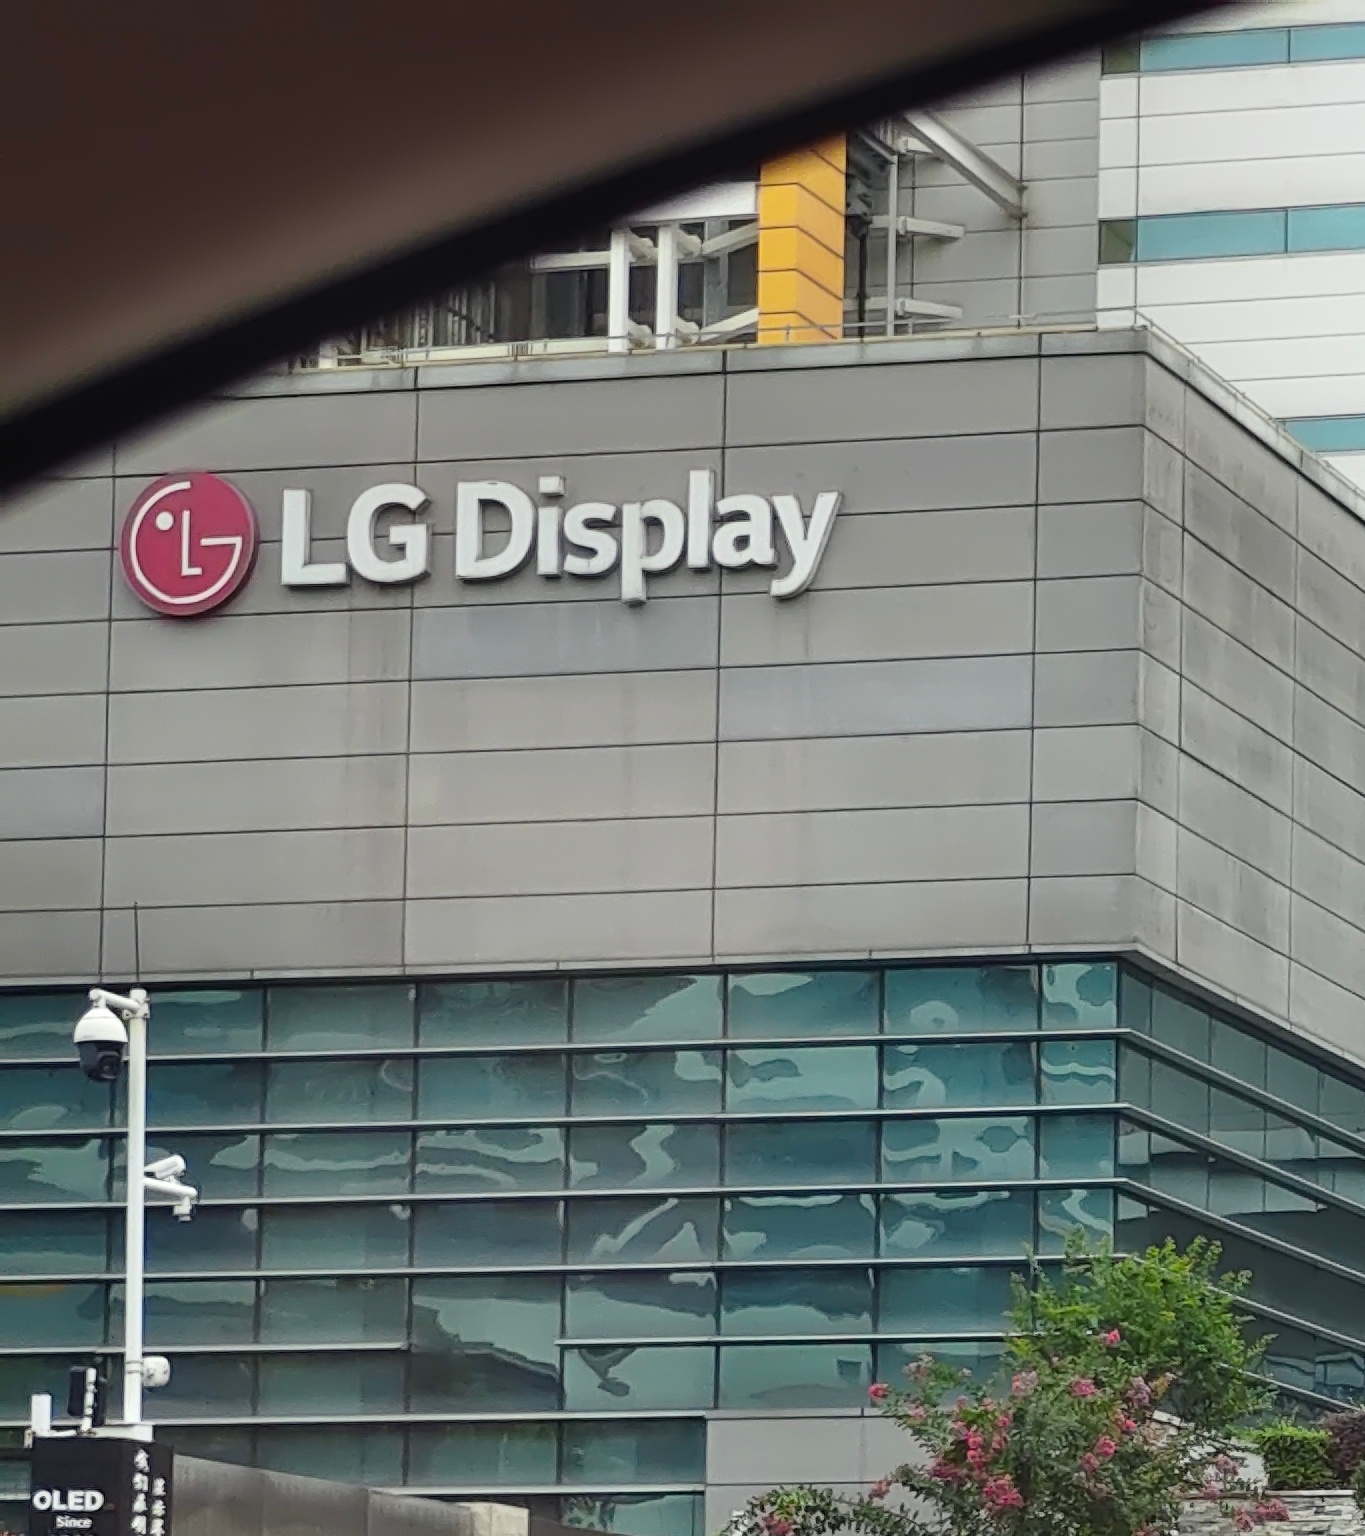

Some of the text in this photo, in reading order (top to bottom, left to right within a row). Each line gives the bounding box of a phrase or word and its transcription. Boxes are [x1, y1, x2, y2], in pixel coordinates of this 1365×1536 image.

[280, 468, 843, 606] LG Display
[32, 1489, 105, 1513] OLED
[56, 1515, 93, 1530] Since
